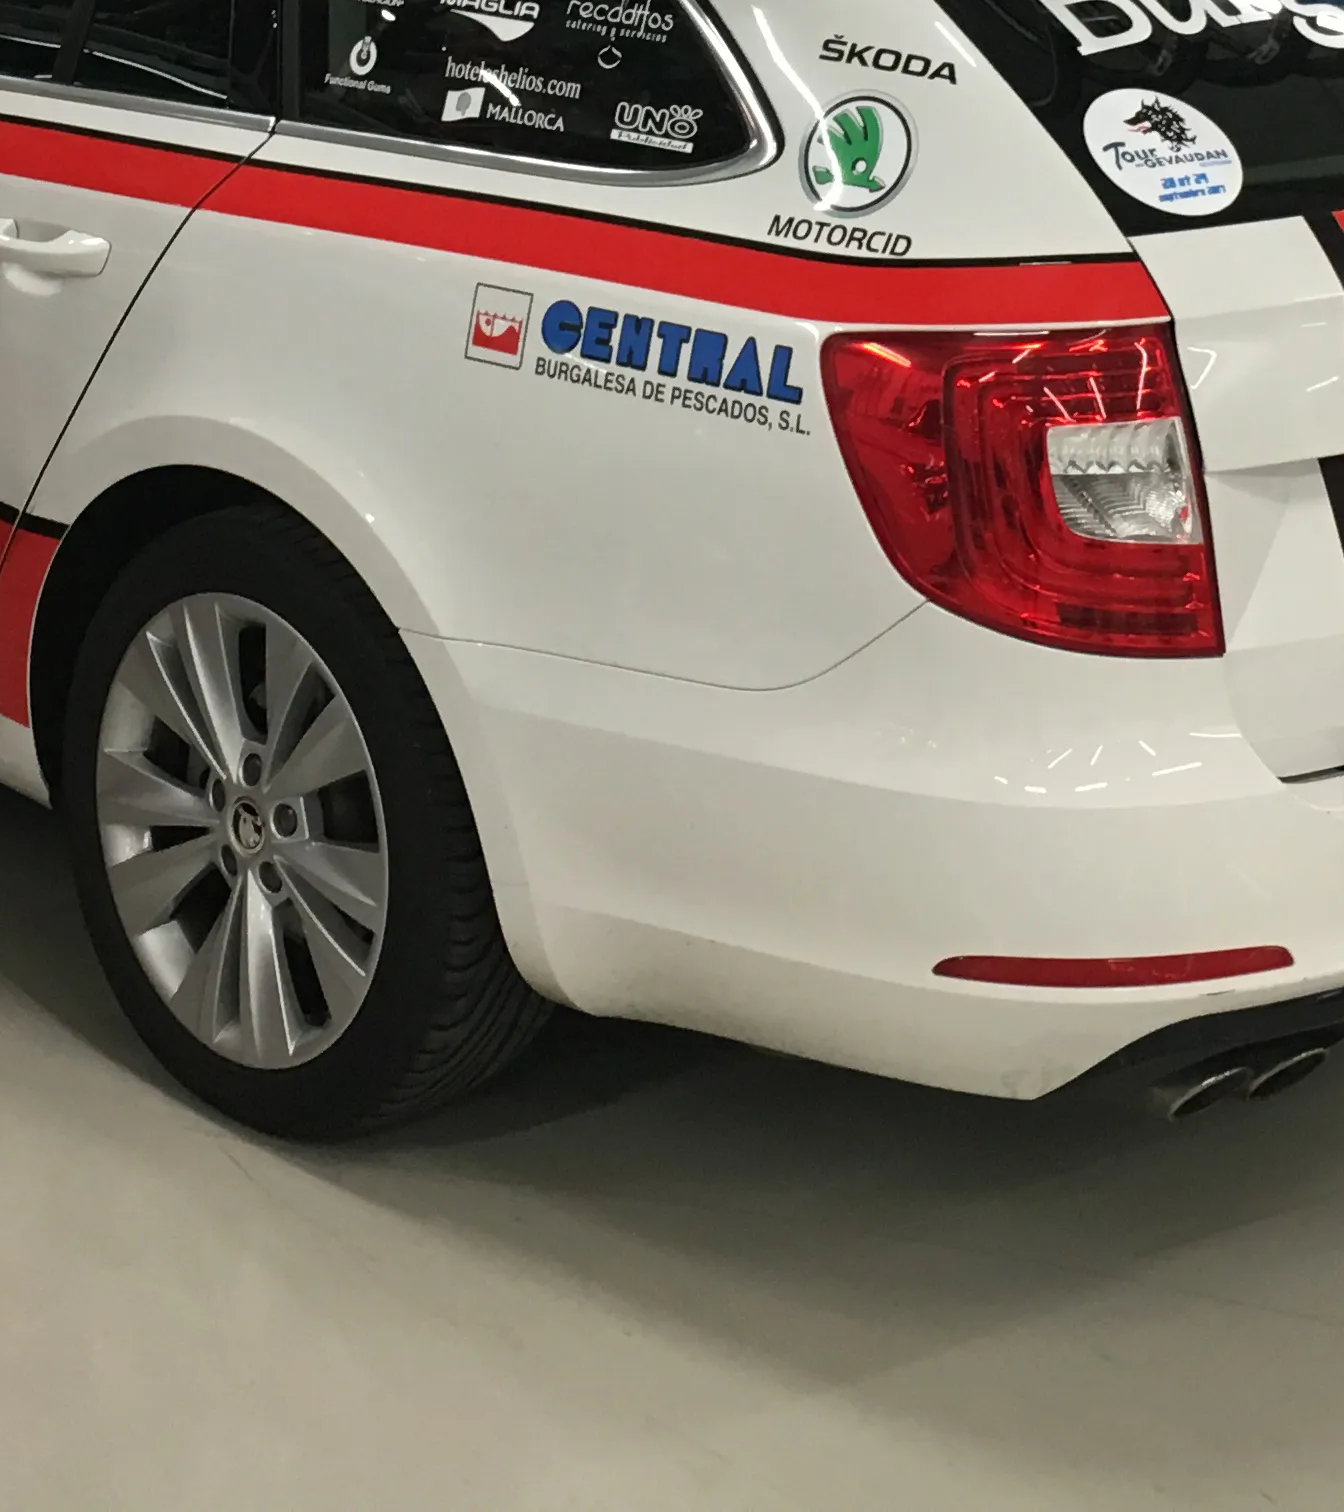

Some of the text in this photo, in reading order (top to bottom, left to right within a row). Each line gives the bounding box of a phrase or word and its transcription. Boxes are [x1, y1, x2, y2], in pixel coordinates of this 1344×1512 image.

[819, 33, 958, 86] ŠKODA
[486, 101, 565, 133] MALLORCA
[614, 100, 704, 139] UNO
[1102, 141, 1158, 171] Tour
[1143, 149, 1229, 169] GEVAUDAN
[767, 214, 913, 258] MOTORCID
[540, 299, 805, 405] CENTRAL
[534, 357, 812, 437] BURGALESA DE PESCADOS, S.L.
